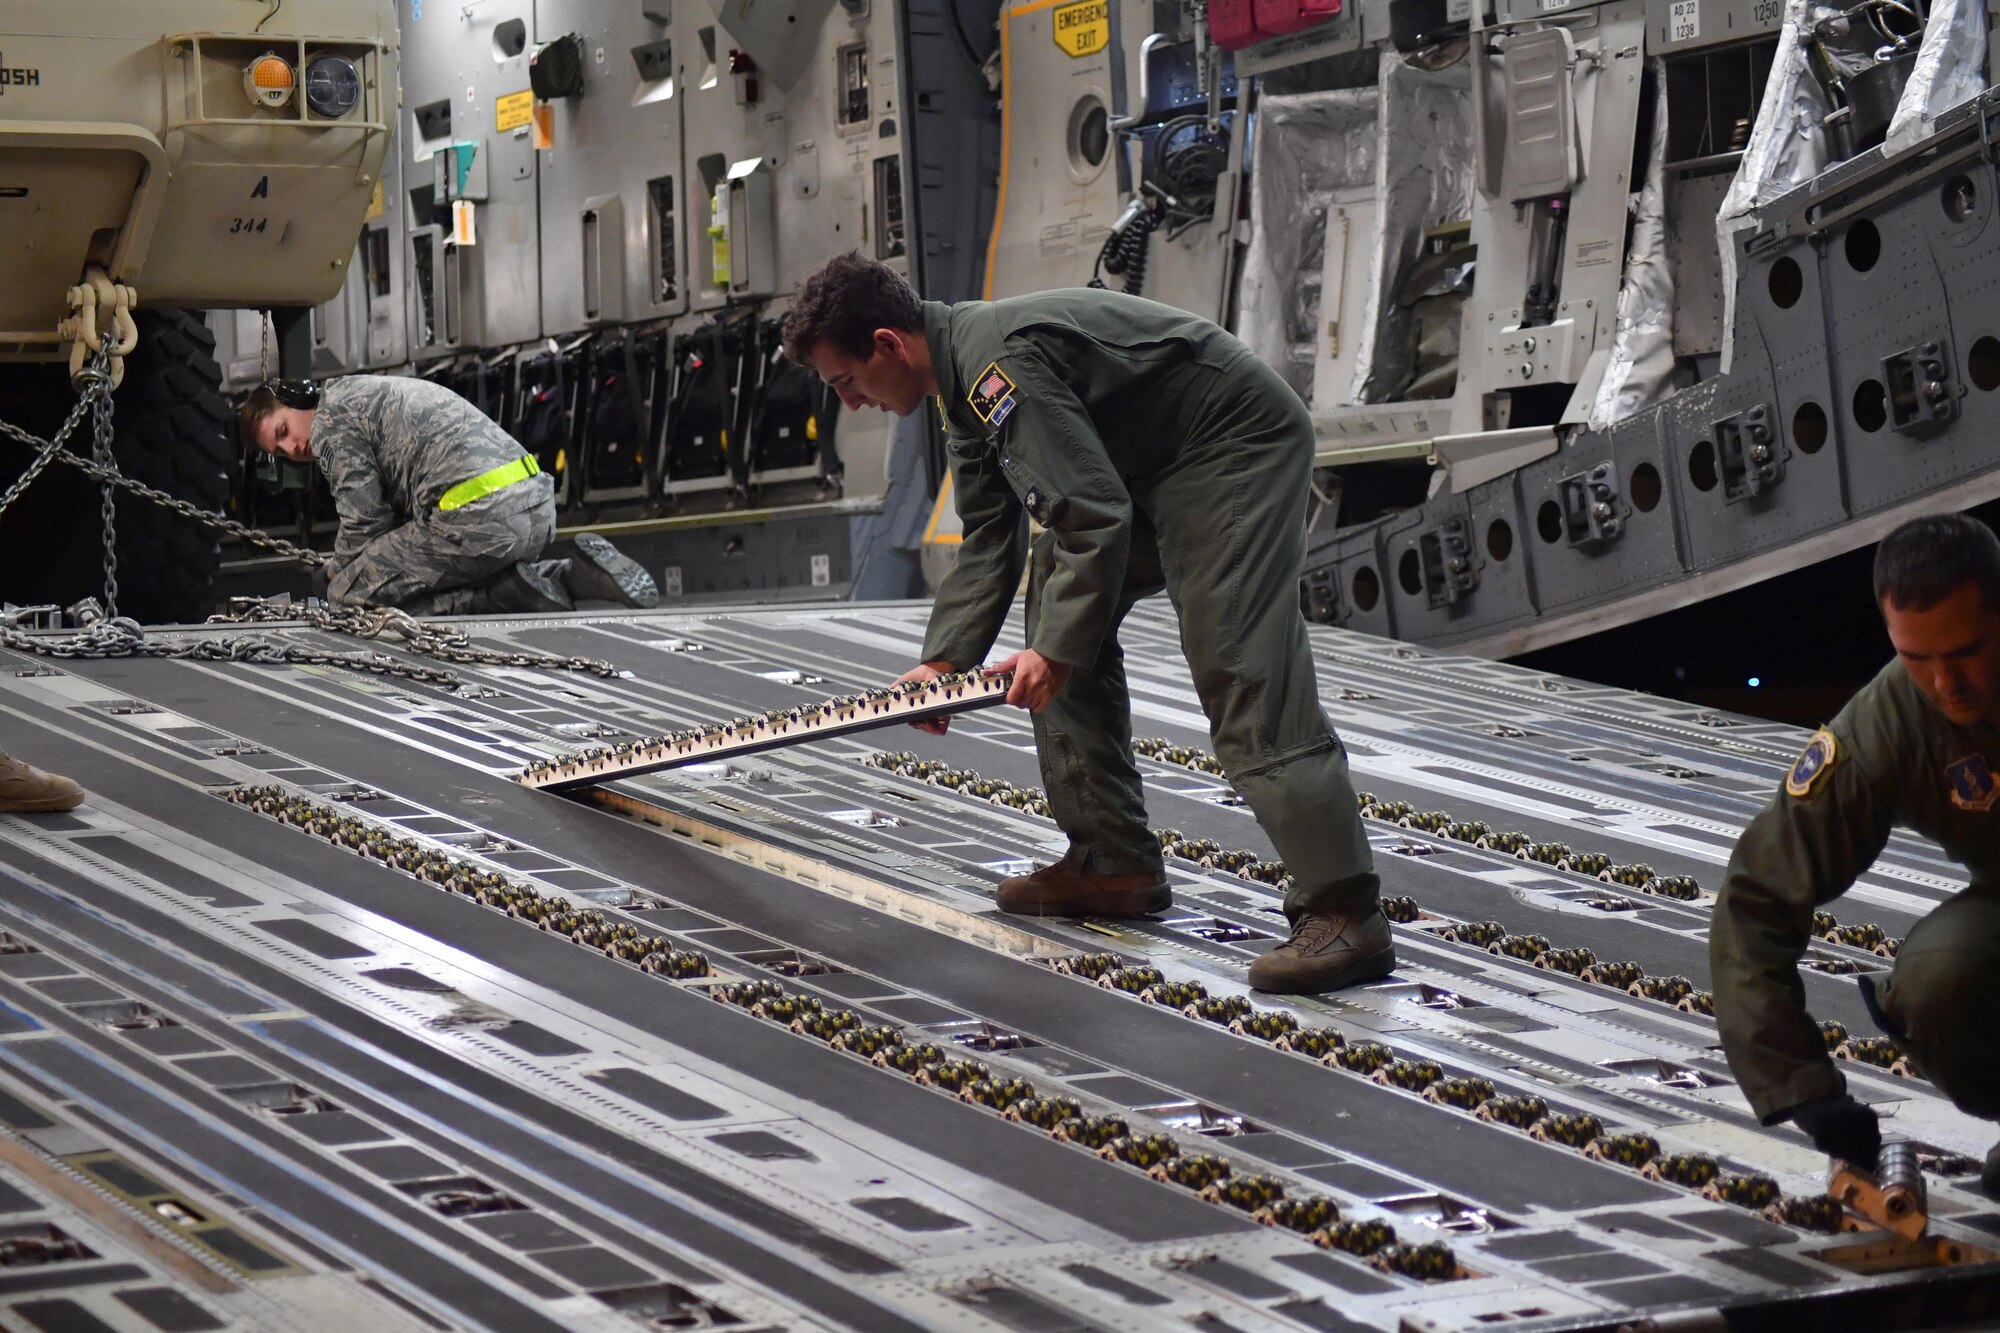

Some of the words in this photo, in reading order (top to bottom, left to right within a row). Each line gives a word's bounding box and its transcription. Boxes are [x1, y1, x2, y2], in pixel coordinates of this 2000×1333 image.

[1059, 2, 1108, 30] EMERGENC
[1674, 4, 1684, 16] AD
[1686, 2, 1695, 14] 22
[1754, 1, 1778, 22] 1250
[1077, 29, 1096, 50] EXIT
[1676, 23, 1694, 38] 1238
[250, 175, 268, 198] A
[230, 217, 267, 234] 344
